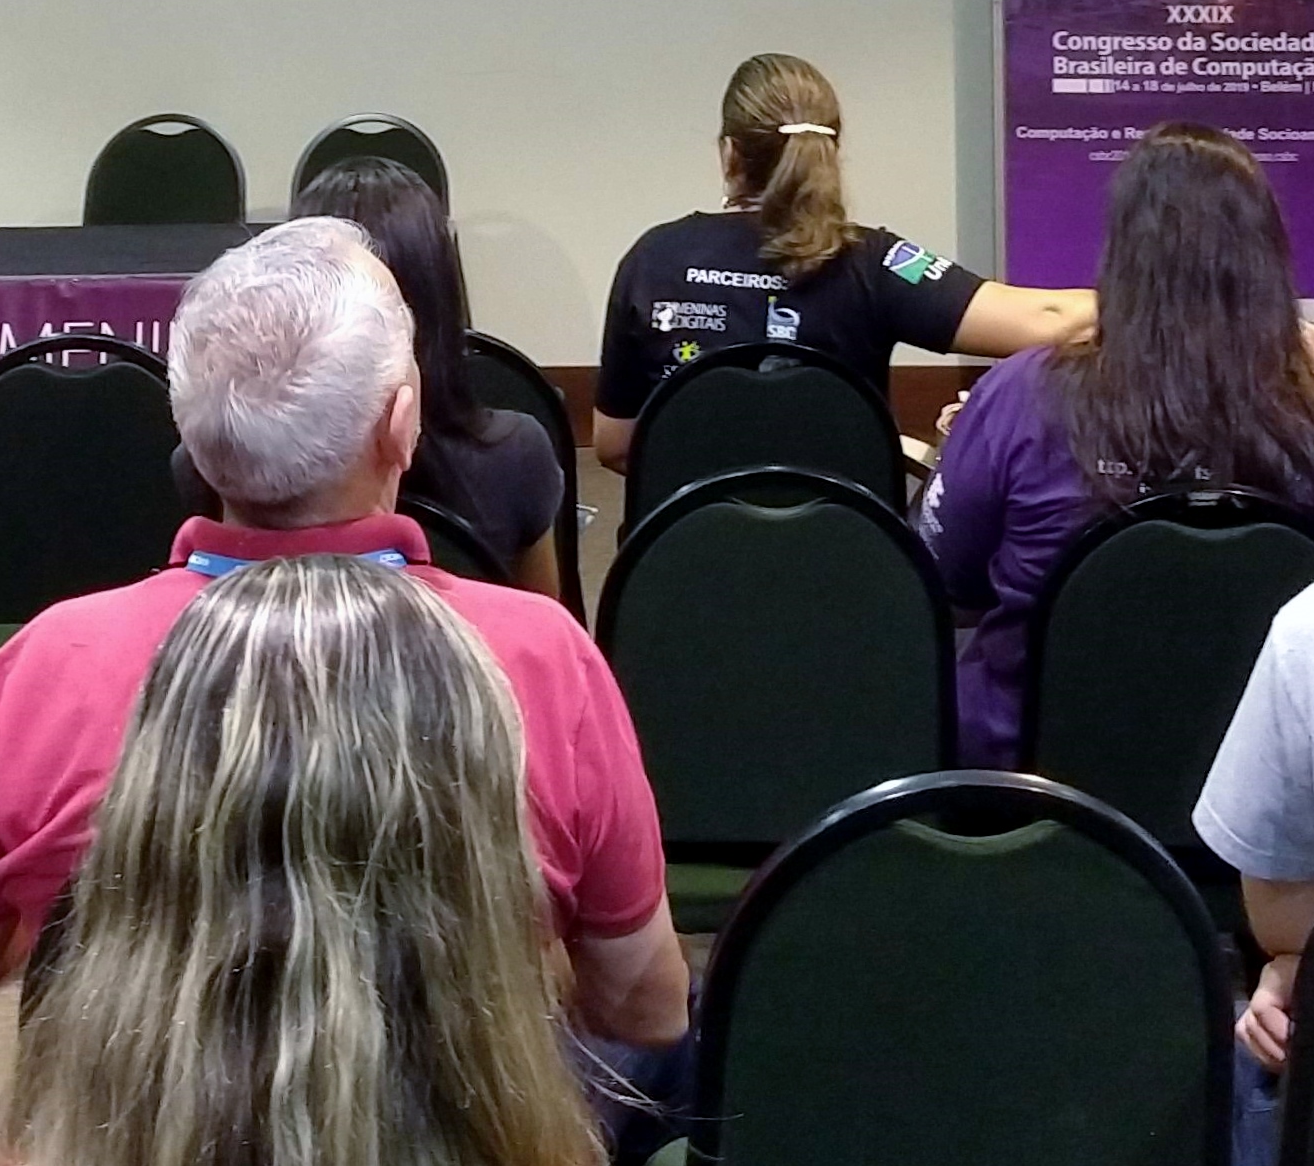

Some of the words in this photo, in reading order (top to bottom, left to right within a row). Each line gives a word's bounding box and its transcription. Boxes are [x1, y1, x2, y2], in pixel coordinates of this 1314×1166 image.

[1167, 5, 1235, 24] XXXIX
[1052, 31, 1172, 54] Congresso
[1177, 32, 1205, 52] da
[1053, 56, 1155, 75] Brasileira
[1160, 56, 1187, 75] de
[1016, 126, 1108, 142] Computação
[686, 268, 788, 289] PARCEIROS:
[676, 302, 727, 317] MENINAS
[674, 316, 727, 331] DIGITAIS
[767, 324, 797, 339] SBC
